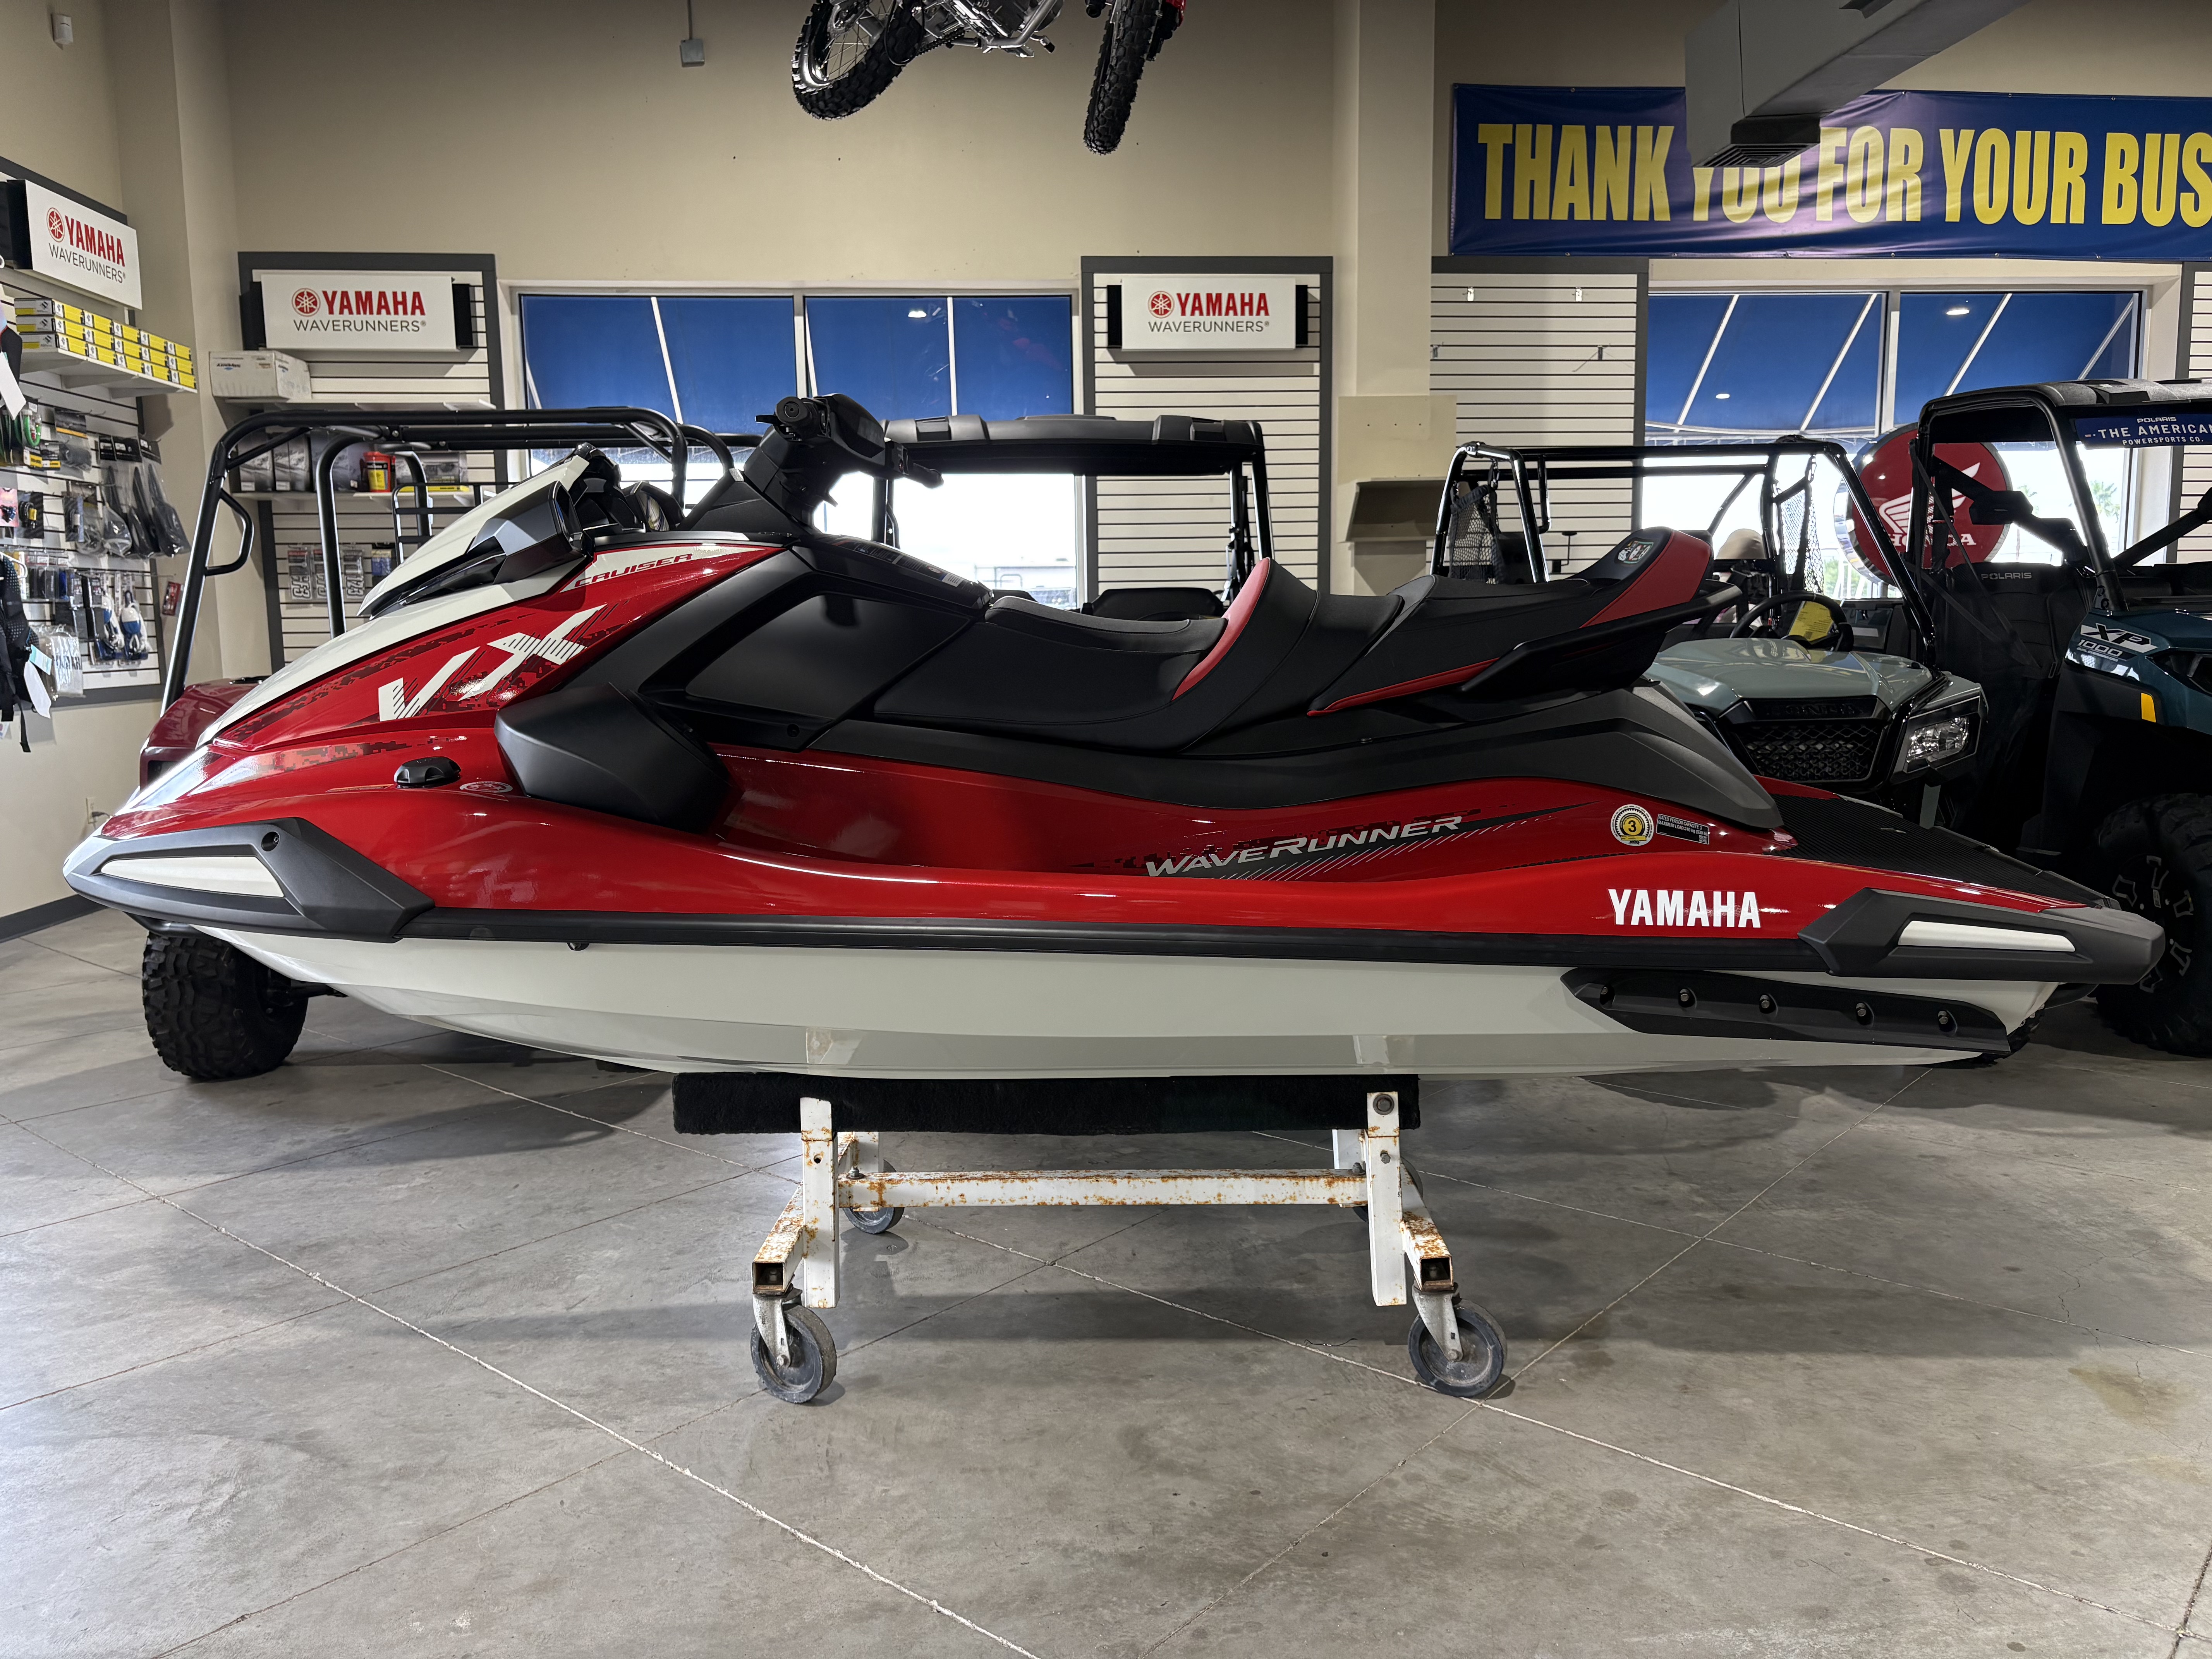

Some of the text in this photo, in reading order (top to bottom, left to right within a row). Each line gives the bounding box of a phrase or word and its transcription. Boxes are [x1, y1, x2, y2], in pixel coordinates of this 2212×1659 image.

[1478, 123, 1674, 221] THANK
[1816, 125, 1923, 223] FOR
[1939, 128, 2088, 225] YOUR
[2102, 132, 2212, 227] BUS
[65, 215, 125, 267] YAMAHA
[322, 290, 426, 316] YAMAHA
[1176, 292, 1270, 317] YAMAHA
[2097, 427, 2131, 439] THE
[2122, 436, 2186, 445] POWERSPORTS
[575, 553, 693, 587] CRUISER
[1981, 572, 2032, 580] POLARIS
[2082, 623, 2150, 646] XP
[2077, 639, 2123, 658] 1000
[378, 603, 608, 722] VX
[1628, 820, 1637, 832] 3
[1608, 889, 1761, 928] YAMAHA
